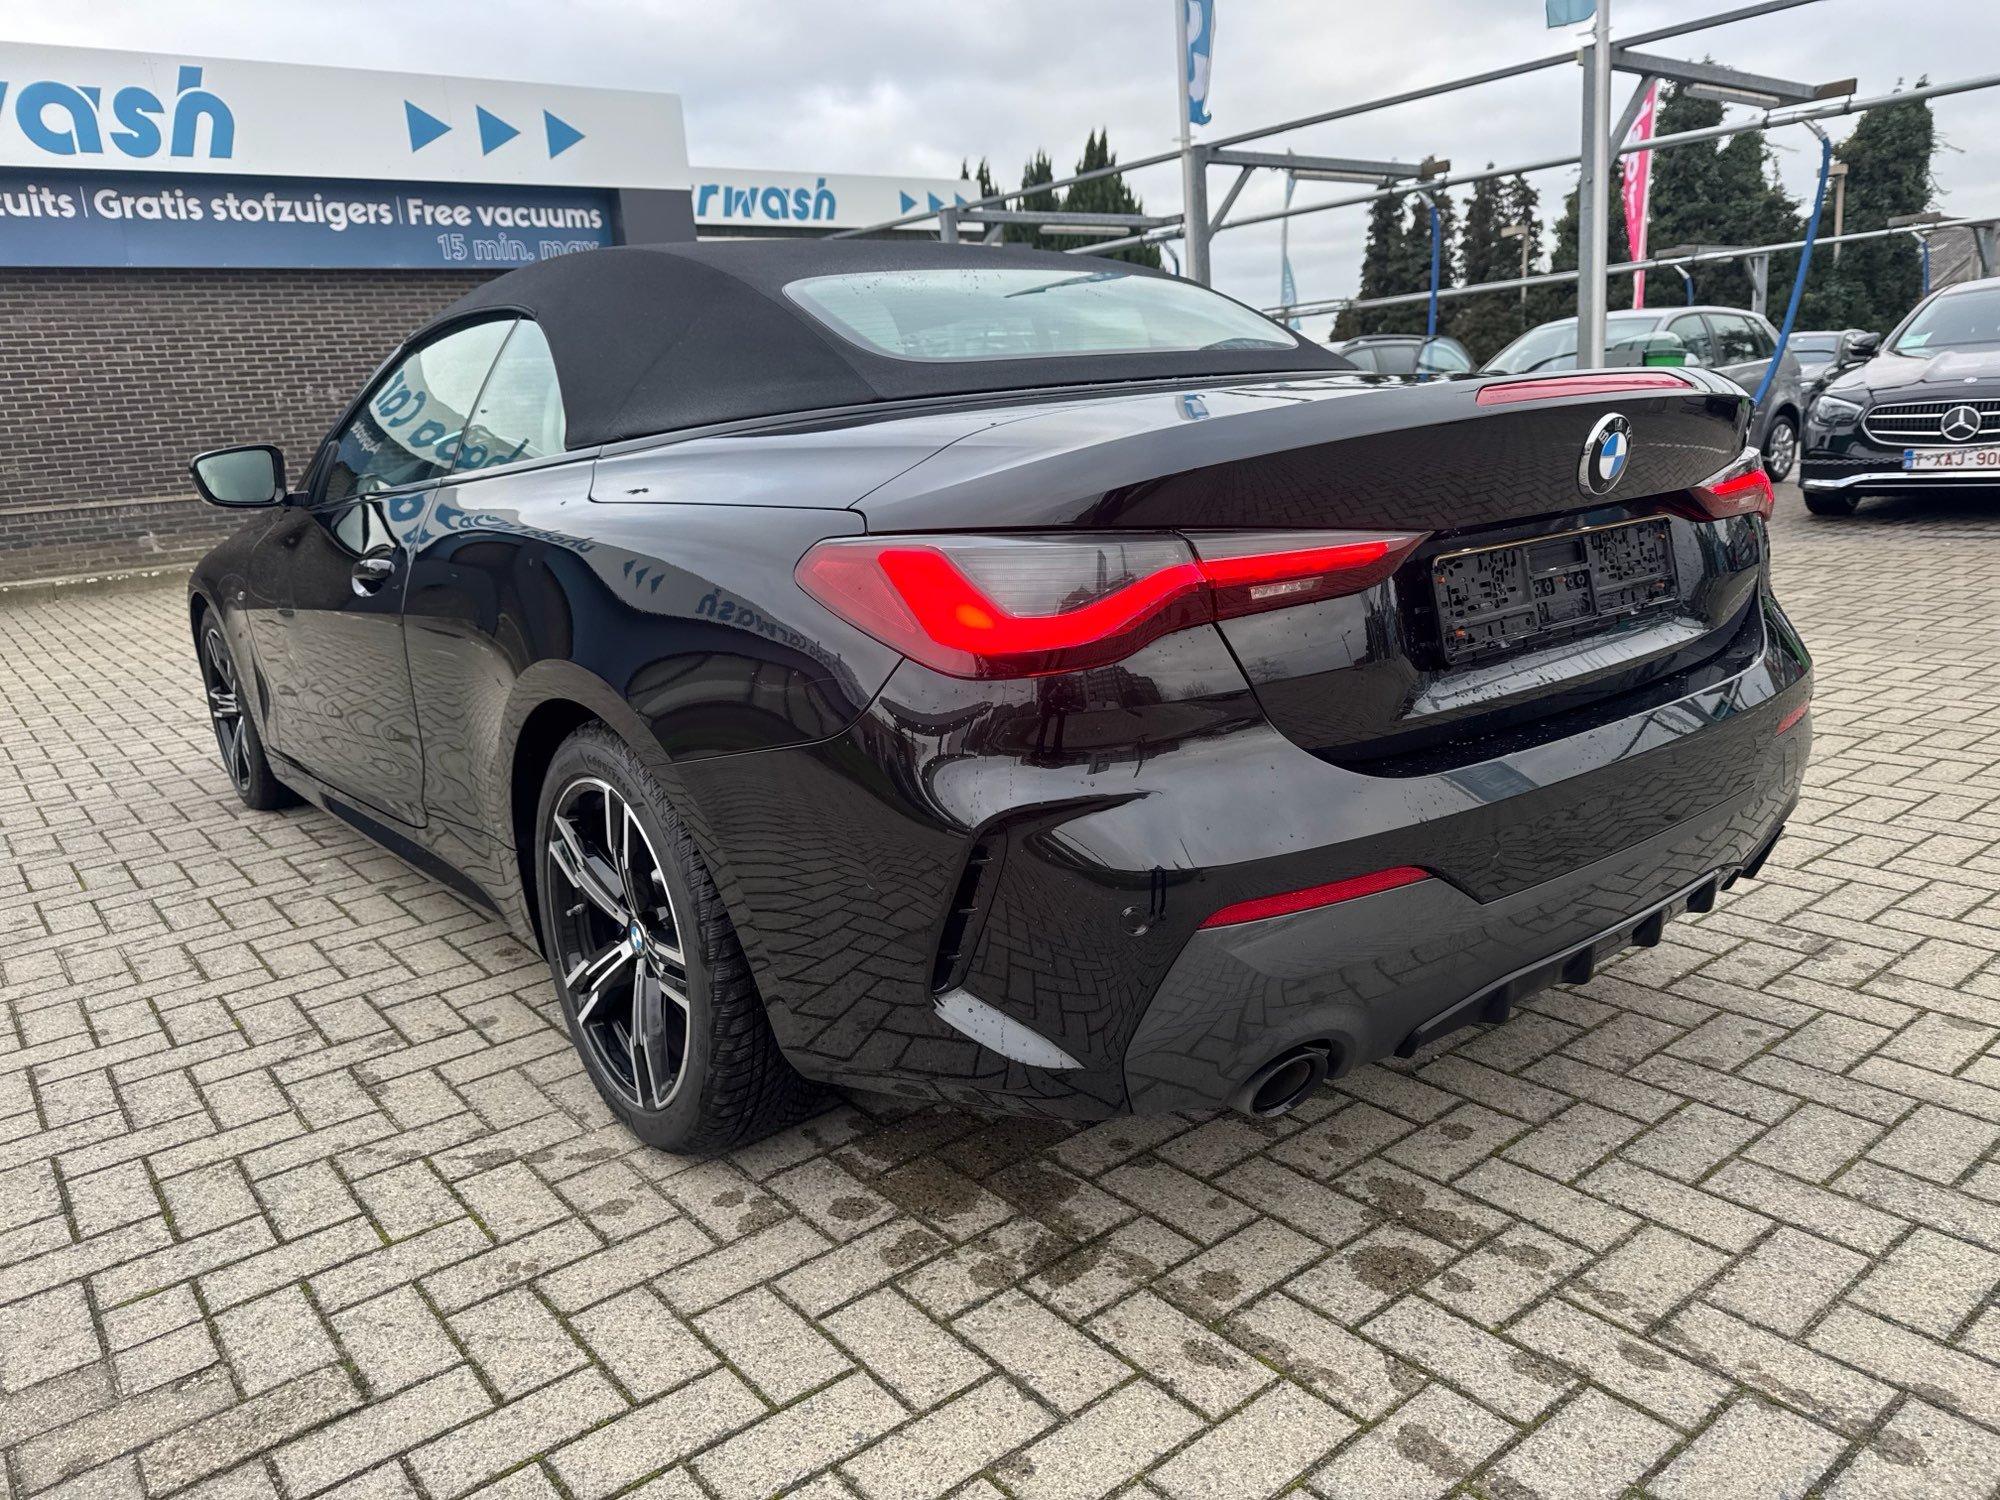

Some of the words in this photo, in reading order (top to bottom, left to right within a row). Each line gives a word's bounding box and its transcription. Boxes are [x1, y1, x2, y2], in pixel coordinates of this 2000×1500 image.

[0, 65, 236, 159] ash
[94, 188, 204, 220] Gratis
[210, 192, 393, 232] stofzuigers
[407, 198, 472, 226] Free
[476, 204, 603, 229] vacuums
[691, 177, 836, 221] rwash
[437, 233, 468, 261] 15
[473, 232, 535, 261] min.
